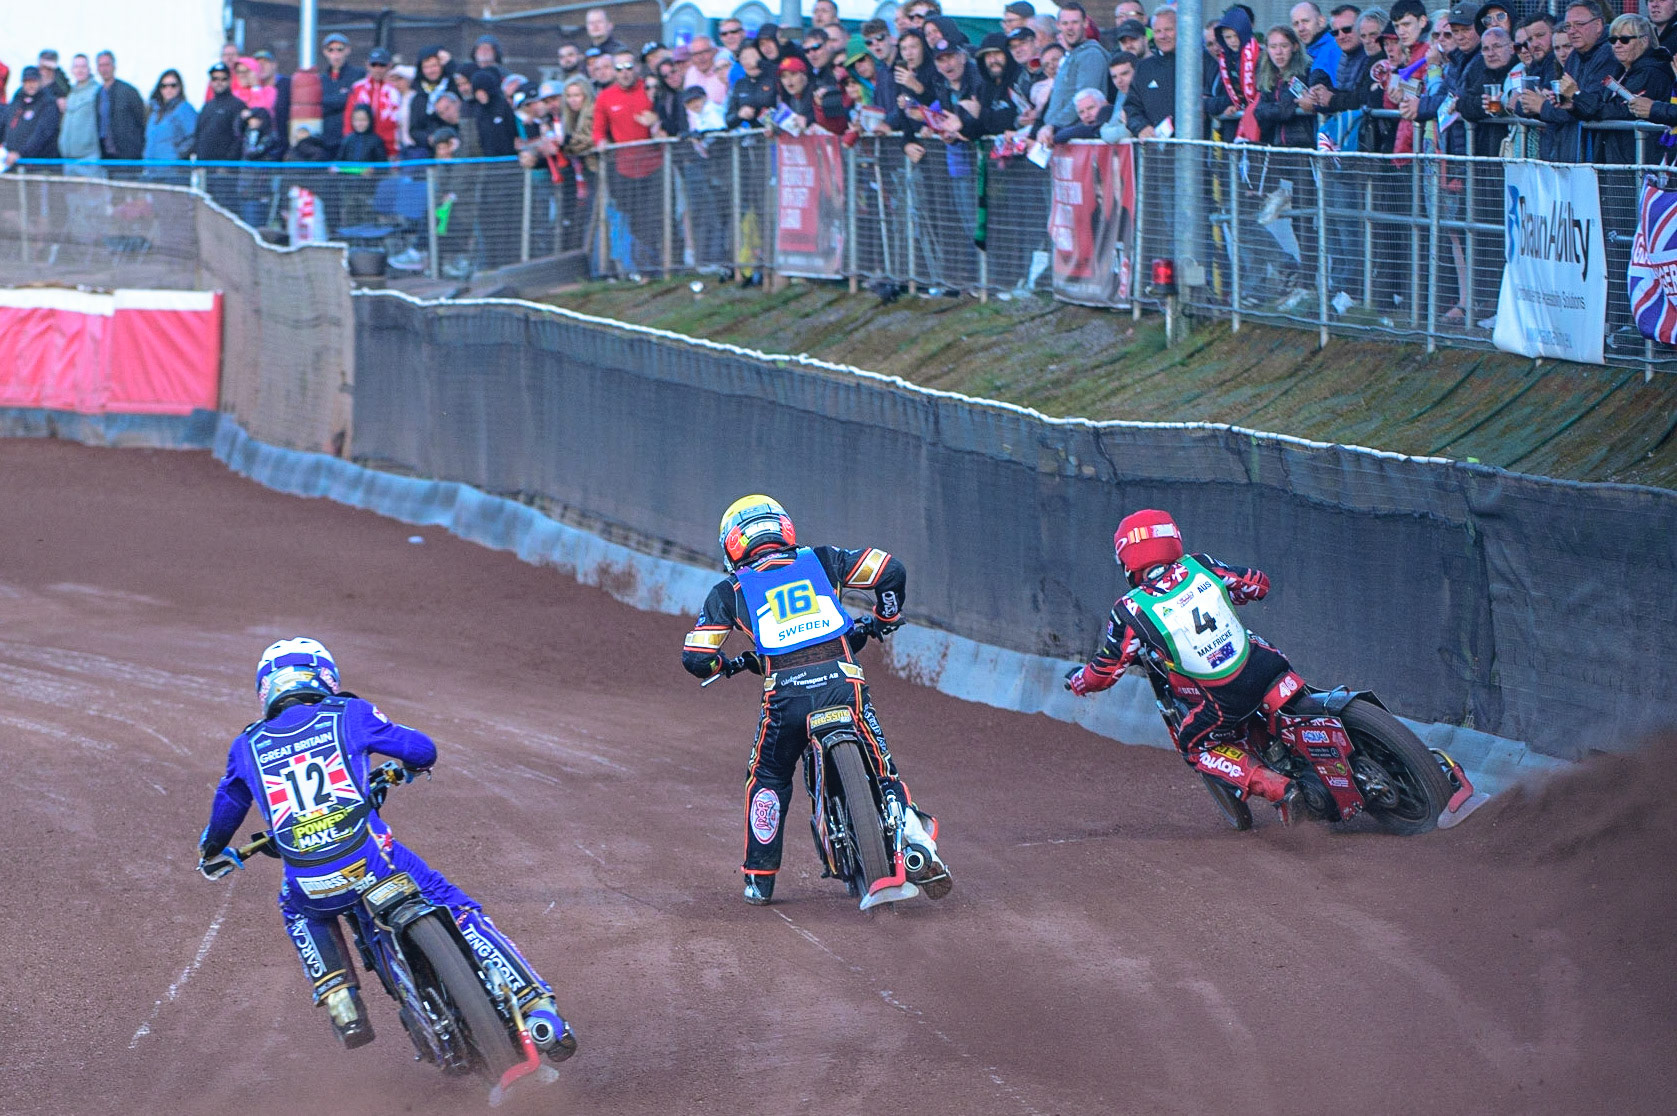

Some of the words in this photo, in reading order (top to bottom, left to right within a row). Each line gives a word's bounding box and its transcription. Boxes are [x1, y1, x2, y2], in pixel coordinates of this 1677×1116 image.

[774, 583, 813, 620] 16
[1197, 580, 1212, 594] AUS
[778, 619, 830, 641] SWEDEN
[1191, 606, 1218, 635] 4
[1197, 643, 1214, 658] MAX
[1212, 629, 1233, 649] FRICKE
[793, 675, 828, 686] Transport
[829, 672, 839, 680] AB
[1279, 675, 1298, 698] 46
[259, 744, 292, 764] GREAT
[293, 731, 333, 752] BRITAIN
[284, 762, 332, 812] 12
